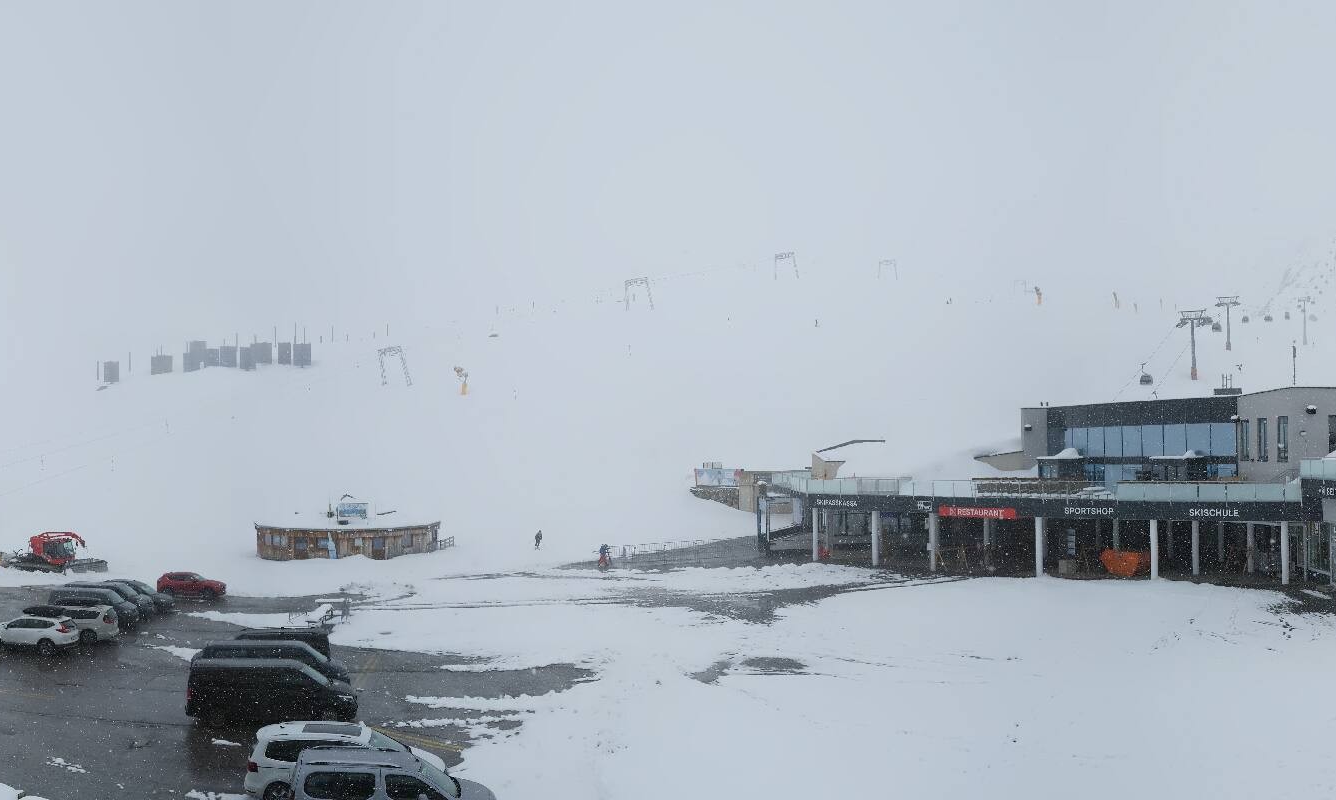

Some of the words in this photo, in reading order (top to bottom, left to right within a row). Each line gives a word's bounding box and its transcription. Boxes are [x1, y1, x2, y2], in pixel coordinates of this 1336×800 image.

[958, 507, 1004, 517] RESTAURANT
[1064, 507, 1114, 515] SPORTSHOP
[1189, 508, 1240, 517] SKISCHULE
